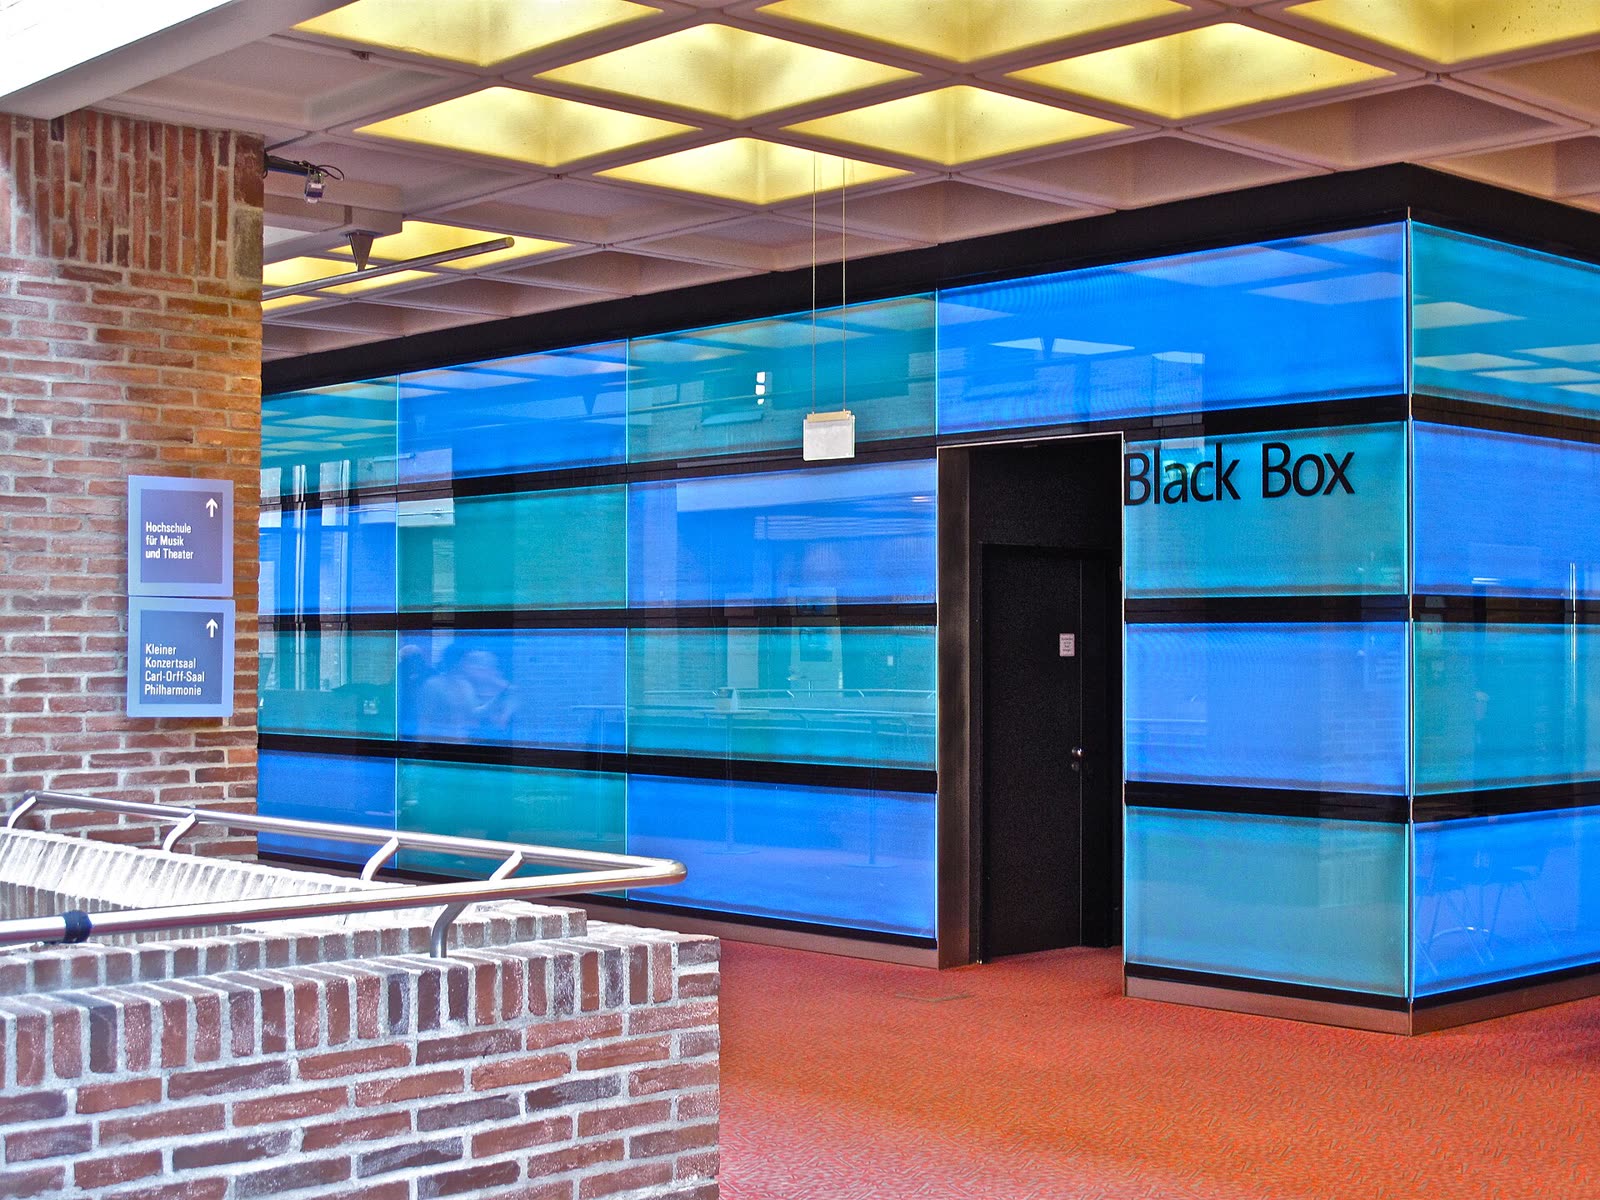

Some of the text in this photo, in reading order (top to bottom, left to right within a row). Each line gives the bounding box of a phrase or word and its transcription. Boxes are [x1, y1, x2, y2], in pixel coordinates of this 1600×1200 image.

[1124, 442, 1355, 506] Black Box
[145, 521, 192, 534] Hochschule
[145, 534, 185, 546] für Musik
[145, 547, 194, 560] und Theater
[145, 643, 177, 655] Kleiner
[145, 656, 196, 669] Konzertsaal
[145, 670, 205, 682] Carl-Orff-Saal
[144, 683, 202, 696] Philharmonie
